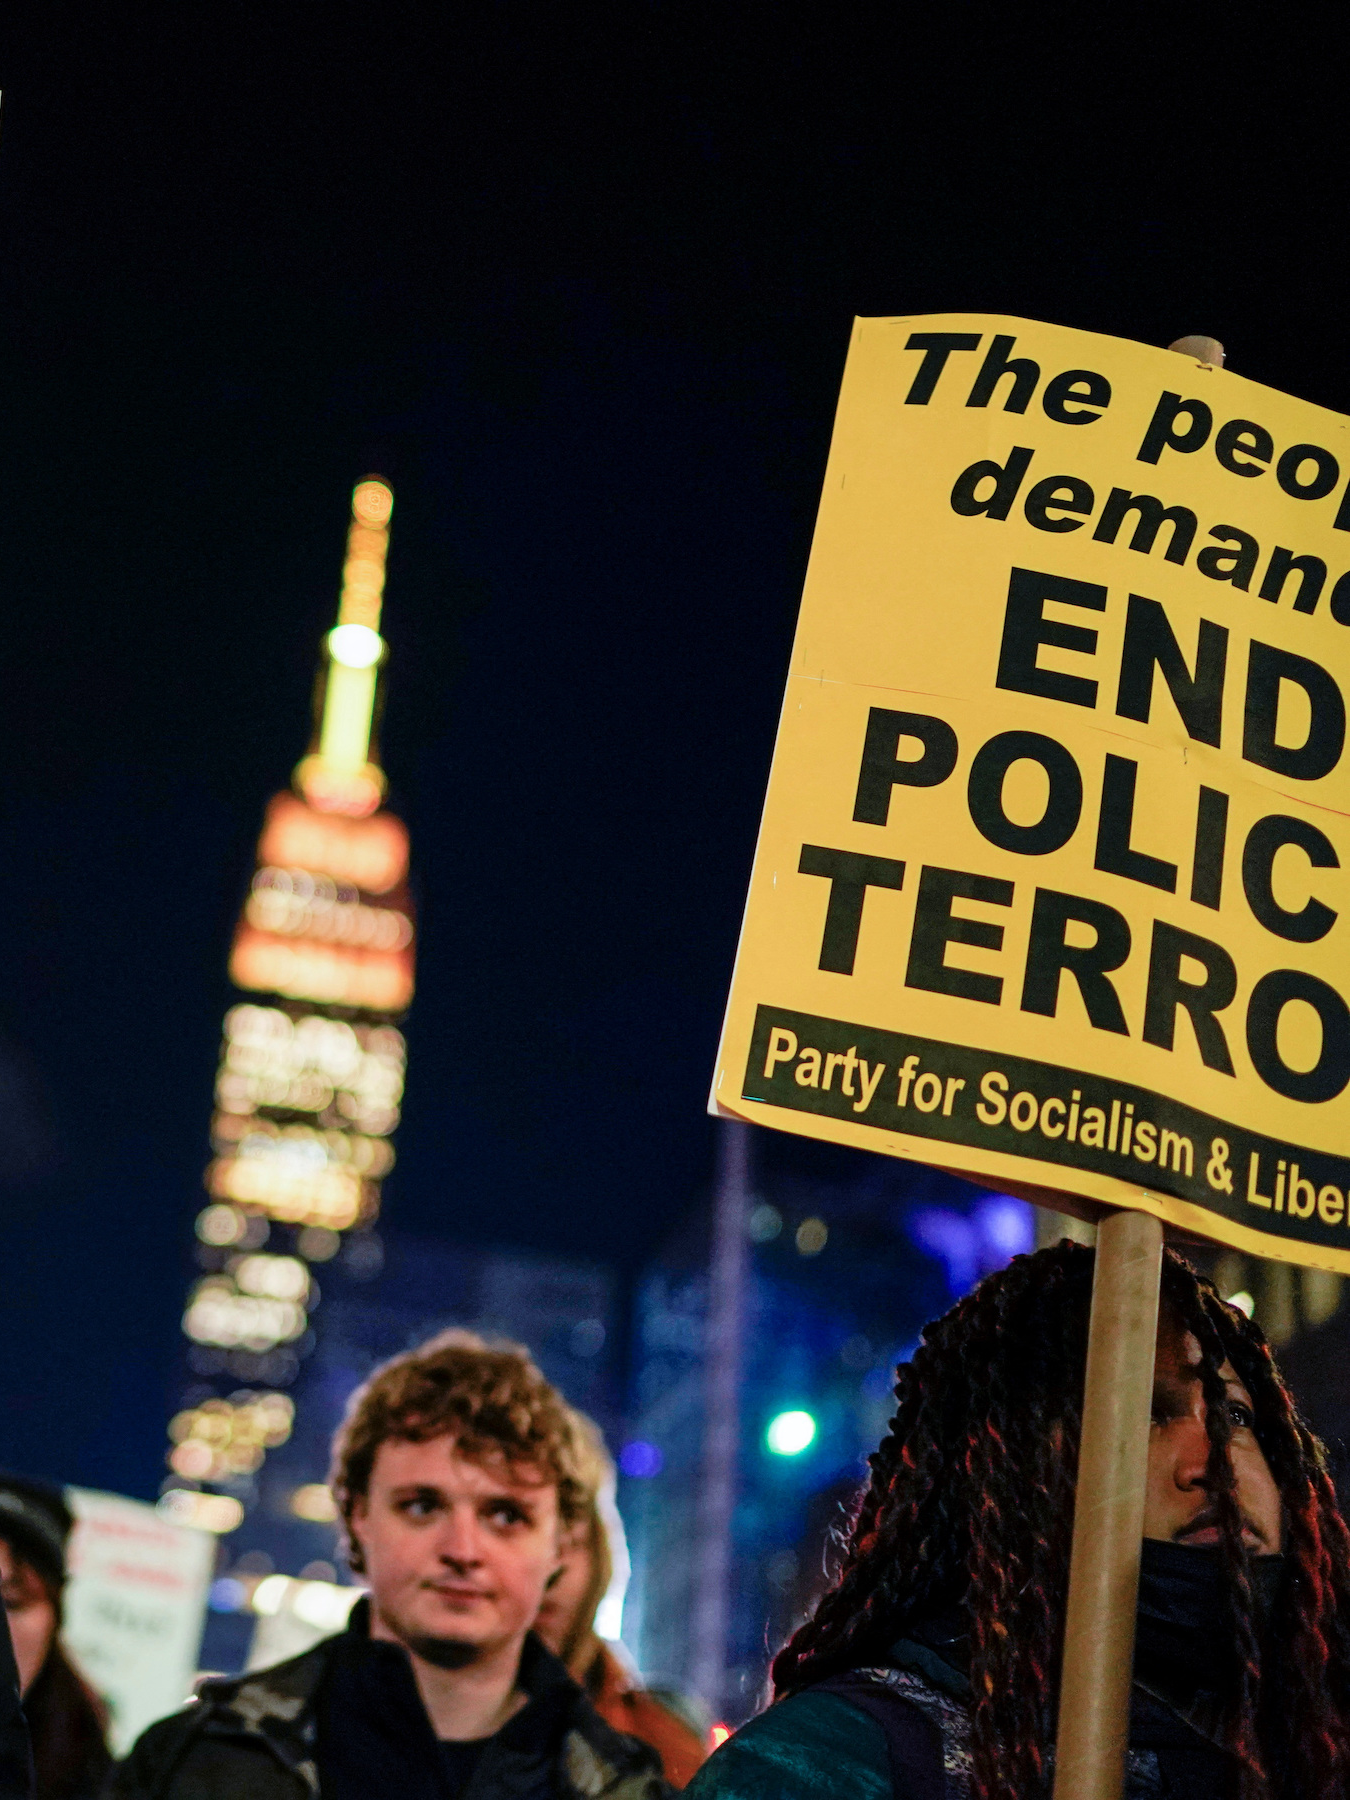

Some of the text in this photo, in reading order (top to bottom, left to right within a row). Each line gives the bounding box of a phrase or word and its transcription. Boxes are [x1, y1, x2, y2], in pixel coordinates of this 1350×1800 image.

[904, 333, 1350, 533] The peo
[996, 567, 1347, 781] END
[853, 707, 1341, 944] POLIC
[798, 843, 1350, 1104] TERRO
[763, 1026, 1350, 1226] Party for Socialism & Libe
